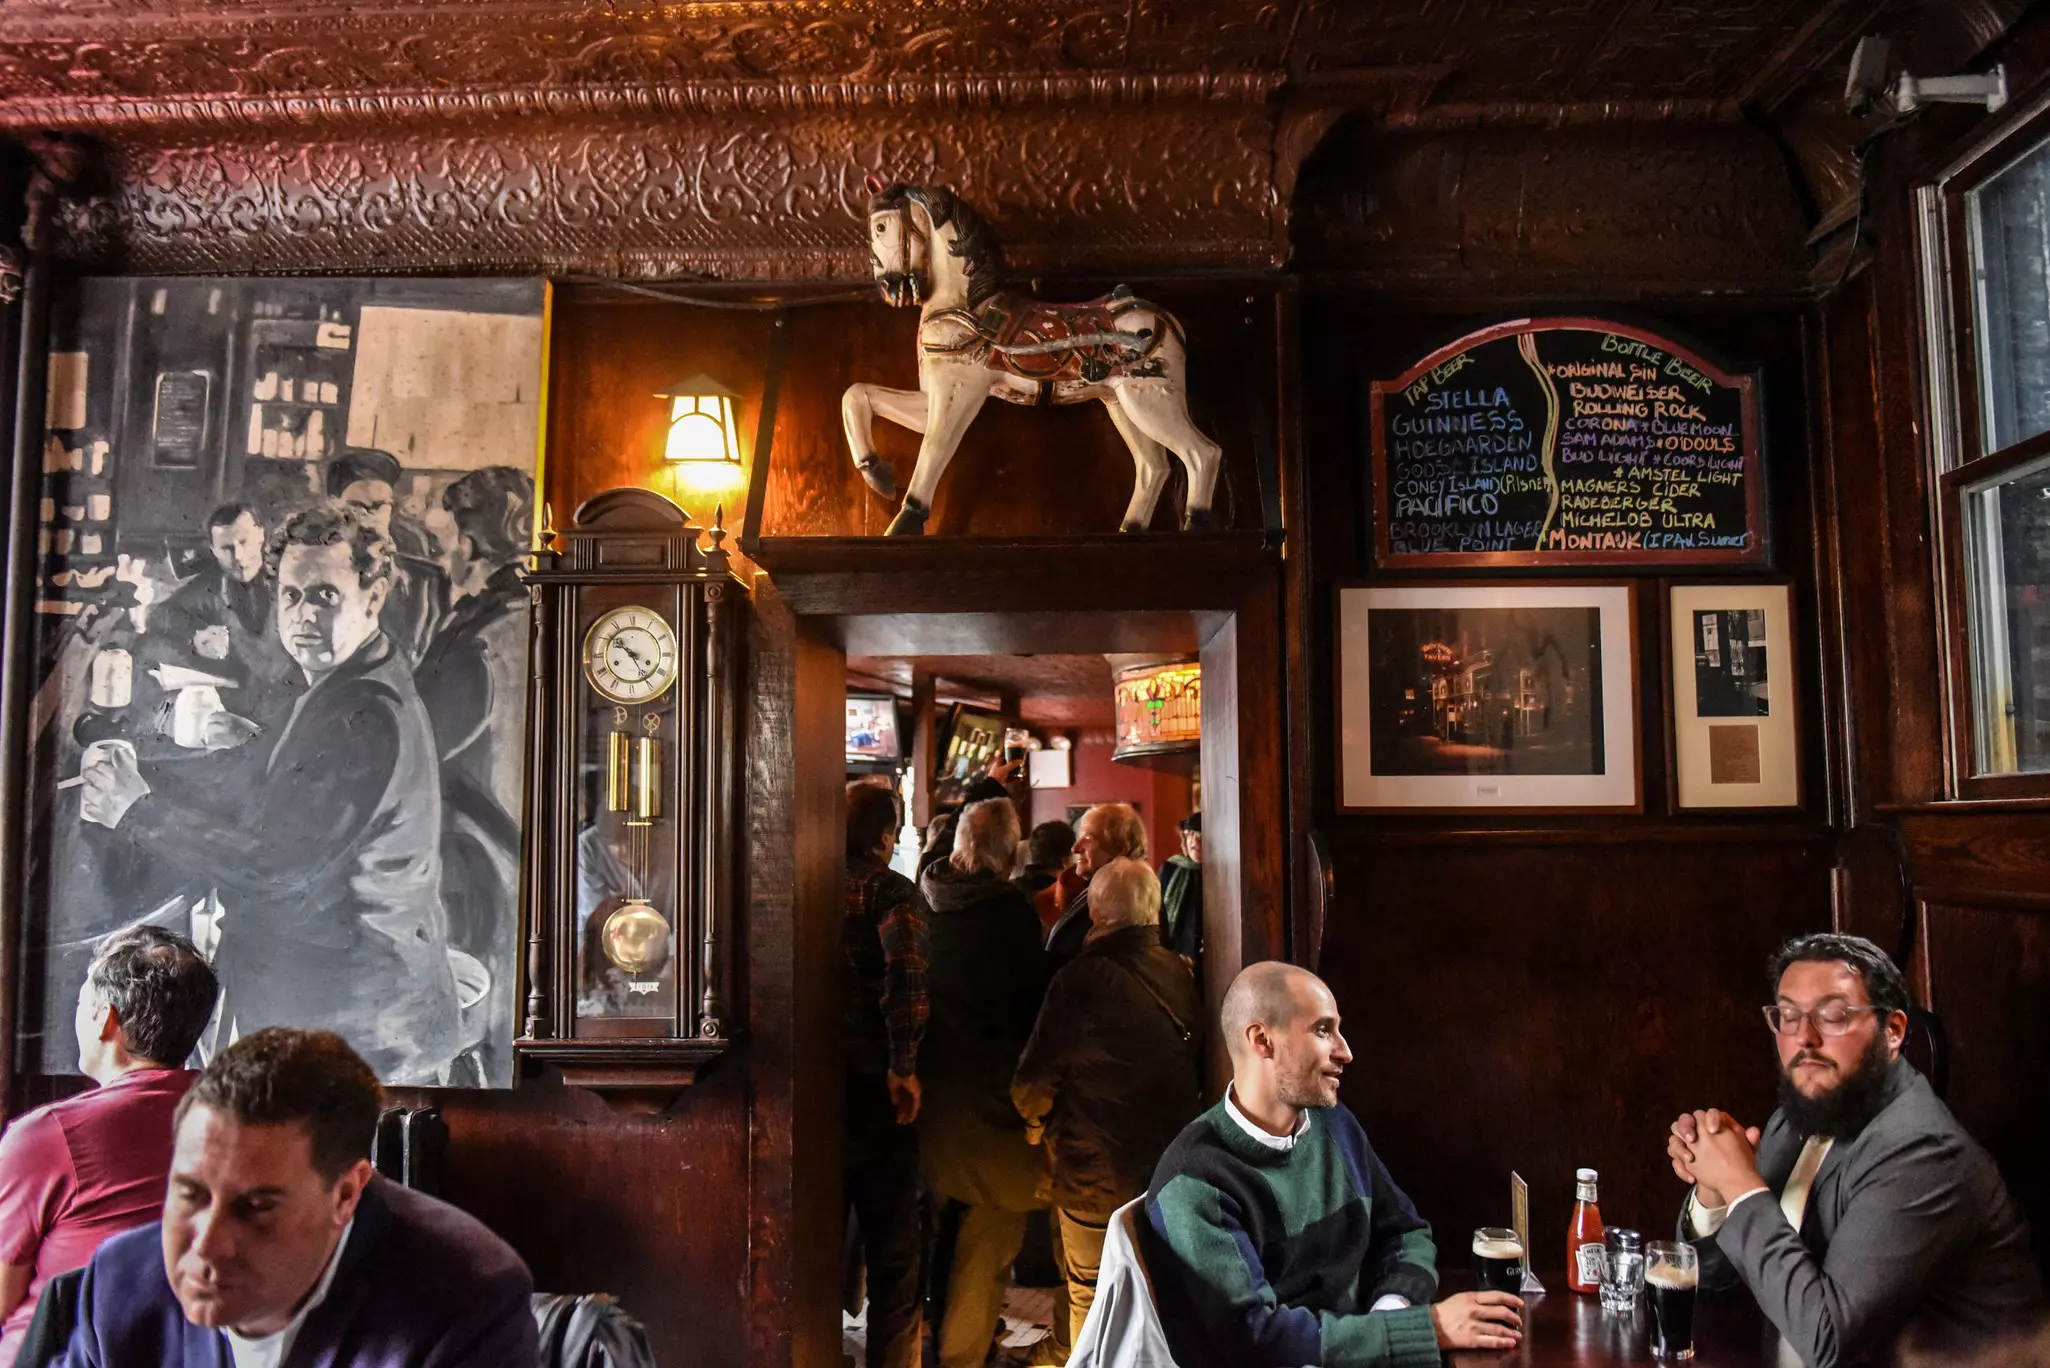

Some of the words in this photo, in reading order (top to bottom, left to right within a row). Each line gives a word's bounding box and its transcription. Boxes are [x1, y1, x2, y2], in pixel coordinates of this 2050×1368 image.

[1601, 334, 1665, 365] BOTTLE
[1664, 356, 1713, 395] BEER
[1630, 363, 1657, 382] SIN
[1404, 375, 1428, 406] TAP
[1430, 354, 1475, 385] BEER
[1425, 386, 1510, 413] STELLA
[1570, 382, 1686, 402] BUDWEISER
[1573, 399, 1648, 417] ROLLING
[1654, 401, 1706, 421] ROCK
[1392, 410, 1524, 436] GUINNESS
[1565, 417, 1638, 431] CORONA
[1652, 419, 1687, 436] BLUE
[1690, 422, 1740, 437] MOON
[1395, 430, 1532, 459] HOEGAARDEN
[1560, 433, 1597, 446] SAM
[1600, 434, 1655, 450] ADAMS
[1665, 436, 1735, 454] O'DOULS
[1471, 453, 1538, 476] ISLAND
[1561, 448, 1594, 464] BUD
[1598, 449, 1649, 466] LIGHT
[1663, 452, 1705, 469] COORS
[1628, 466, 1691, 481] AMSTEL
[1697, 470, 1743, 486] LIGHT
[1394, 478, 1445, 499] CONEY
[1561, 478, 1641, 495] MAGNERS
[1653, 481, 1701, 498] CIDER
[1396, 494, 1498, 518] PACIFICO
[1561, 495, 1678, 514] RADEBERGER
[1389, 520, 1491, 540] BROOKLYN
[1496, 520, 1543, 536] LAGER
[1561, 511, 1653, 529] MICHELOB
[1662, 512, 1715, 529] ULTRA
[1459, 536, 1516, 553] POINT
[1549, 529, 1643, 550] MONTAUK
